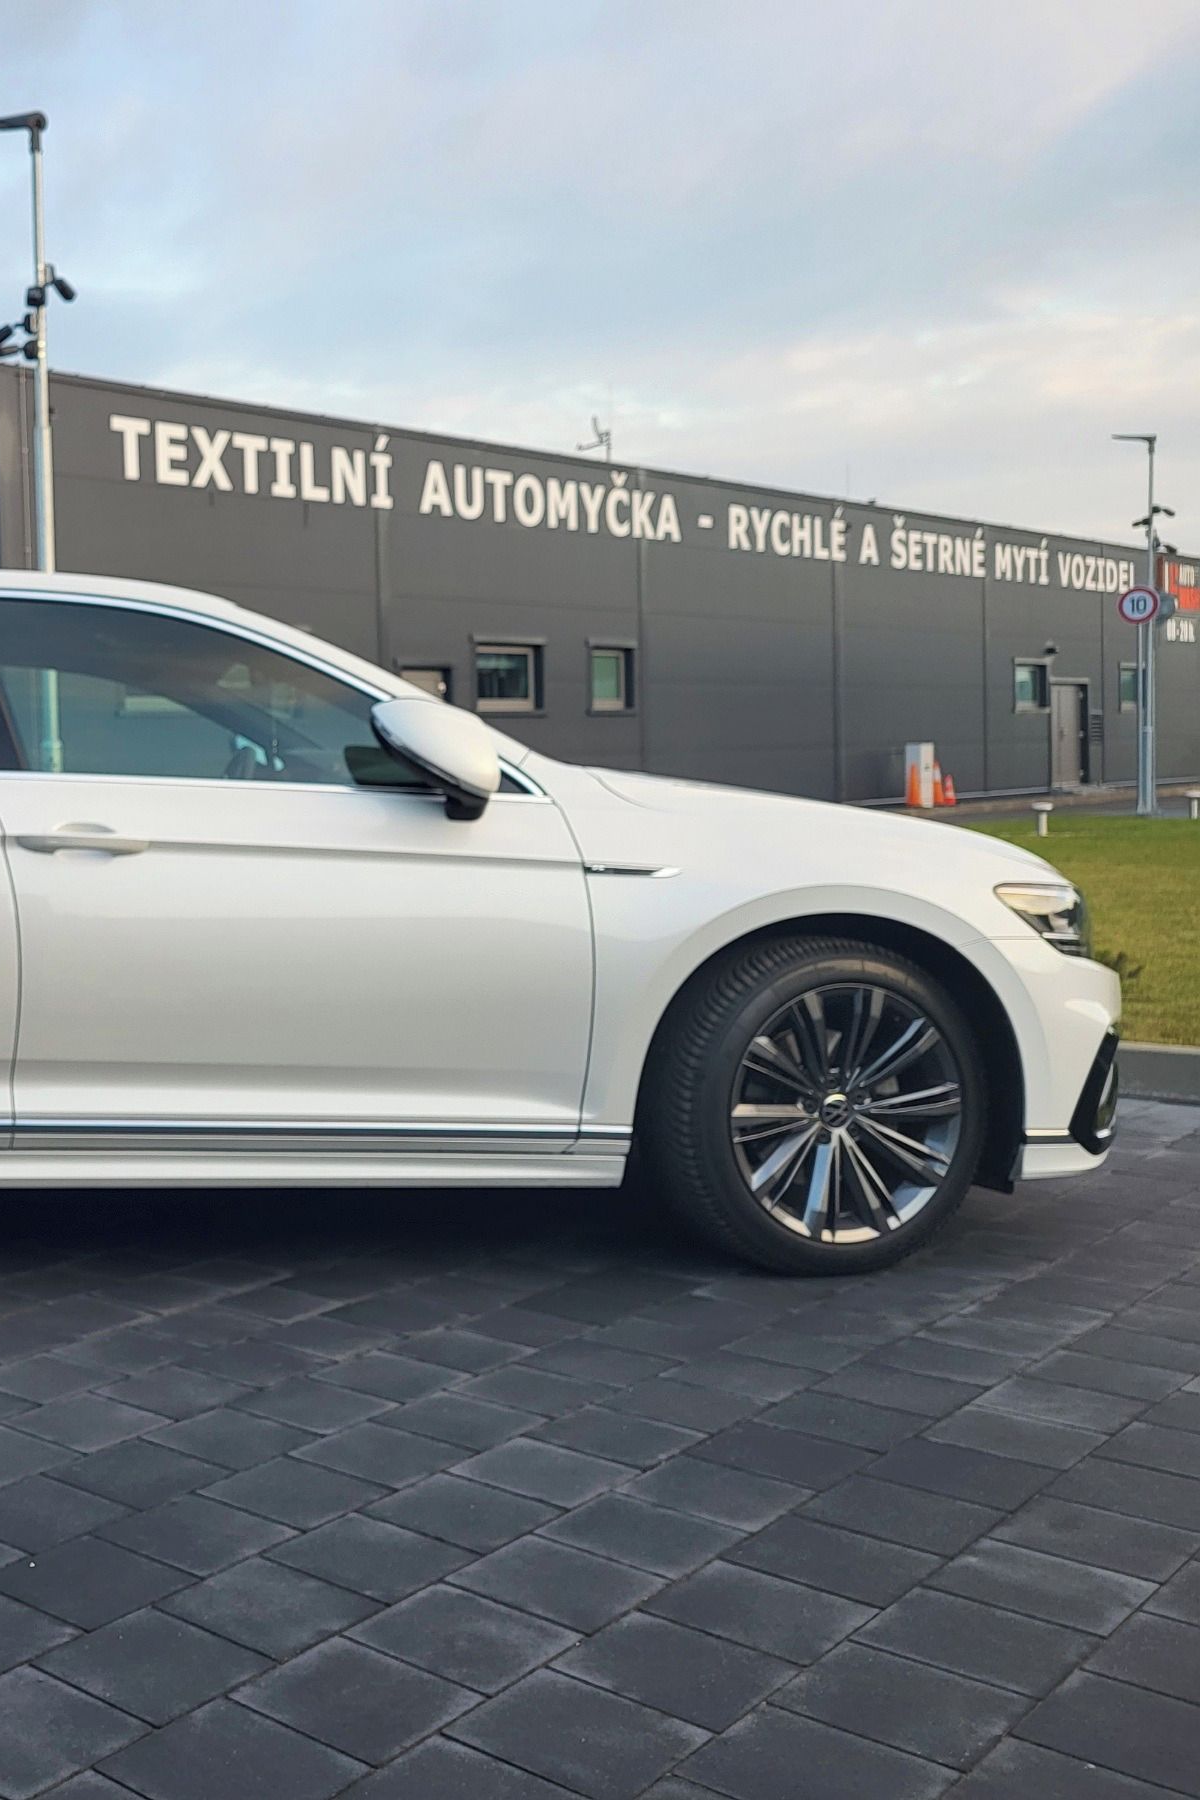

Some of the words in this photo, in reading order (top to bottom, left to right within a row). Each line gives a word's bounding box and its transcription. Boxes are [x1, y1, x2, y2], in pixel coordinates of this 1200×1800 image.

[109, 414, 394, 510] TEXTILNÍ
[419, 459, 682, 543] AUTOMYČKA
[728, 502, 847, 562] RYCHLÉ
[858, 523, 880, 566] A
[890, 514, 987, 578] ŠETRNÉ
[994, 537, 1050, 586] MYTÍ
[1130, 595, 1147, 615] 10
